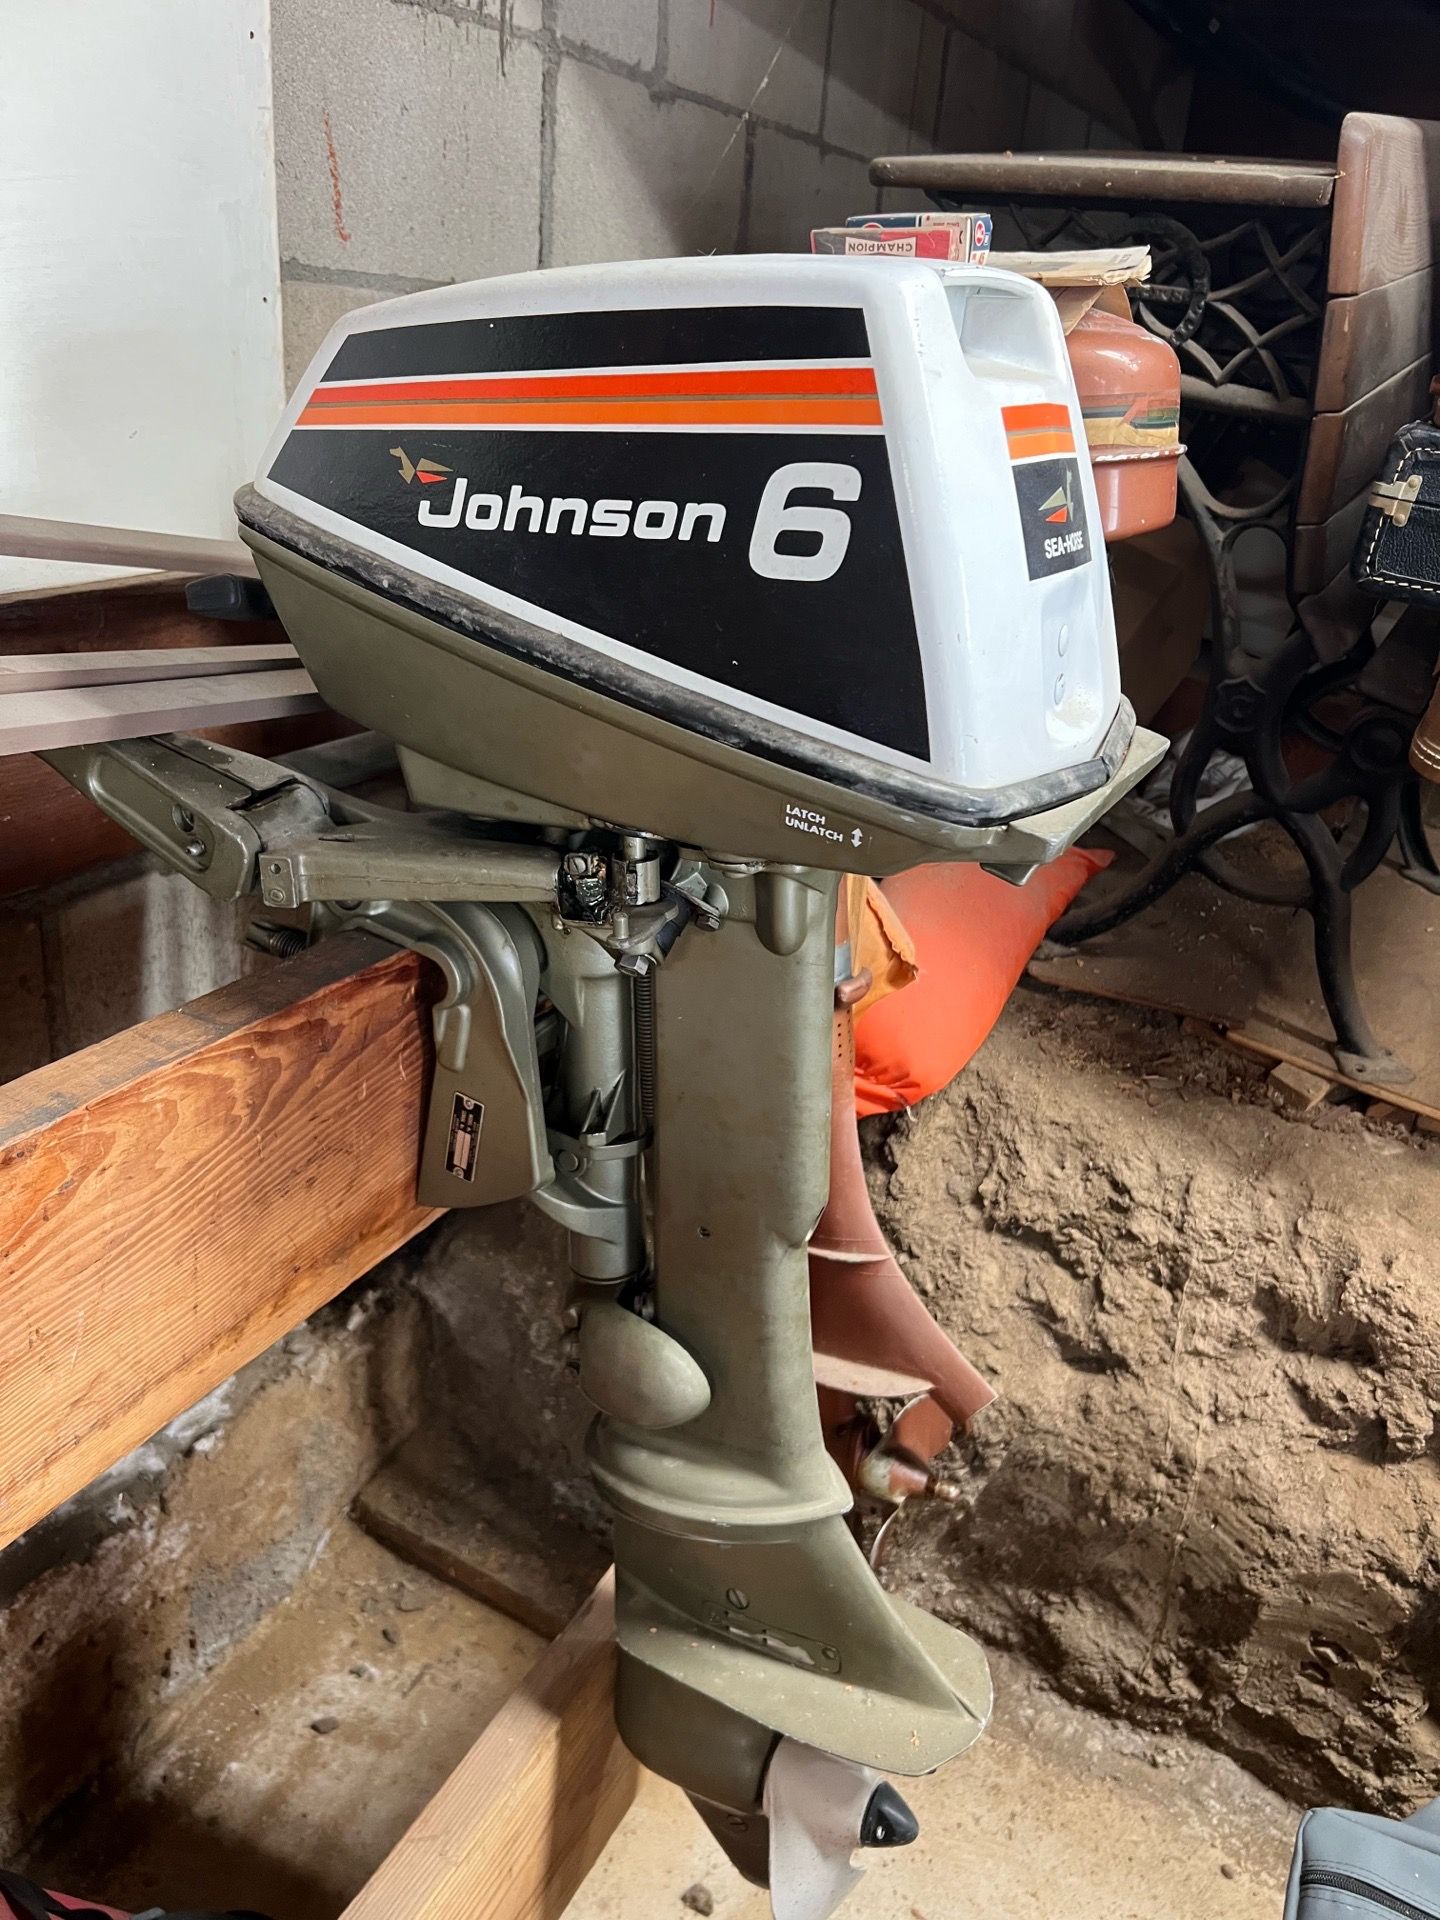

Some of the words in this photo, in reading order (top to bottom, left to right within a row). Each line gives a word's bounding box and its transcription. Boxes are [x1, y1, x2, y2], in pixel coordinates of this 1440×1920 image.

[848, 242, 913, 253] CHAMPION
[418, 477, 727, 542] Johnson
[748, 462, 862, 582] 6
[786, 804, 825, 825] LATCH
[785, 816, 843, 843] UNLATCH
